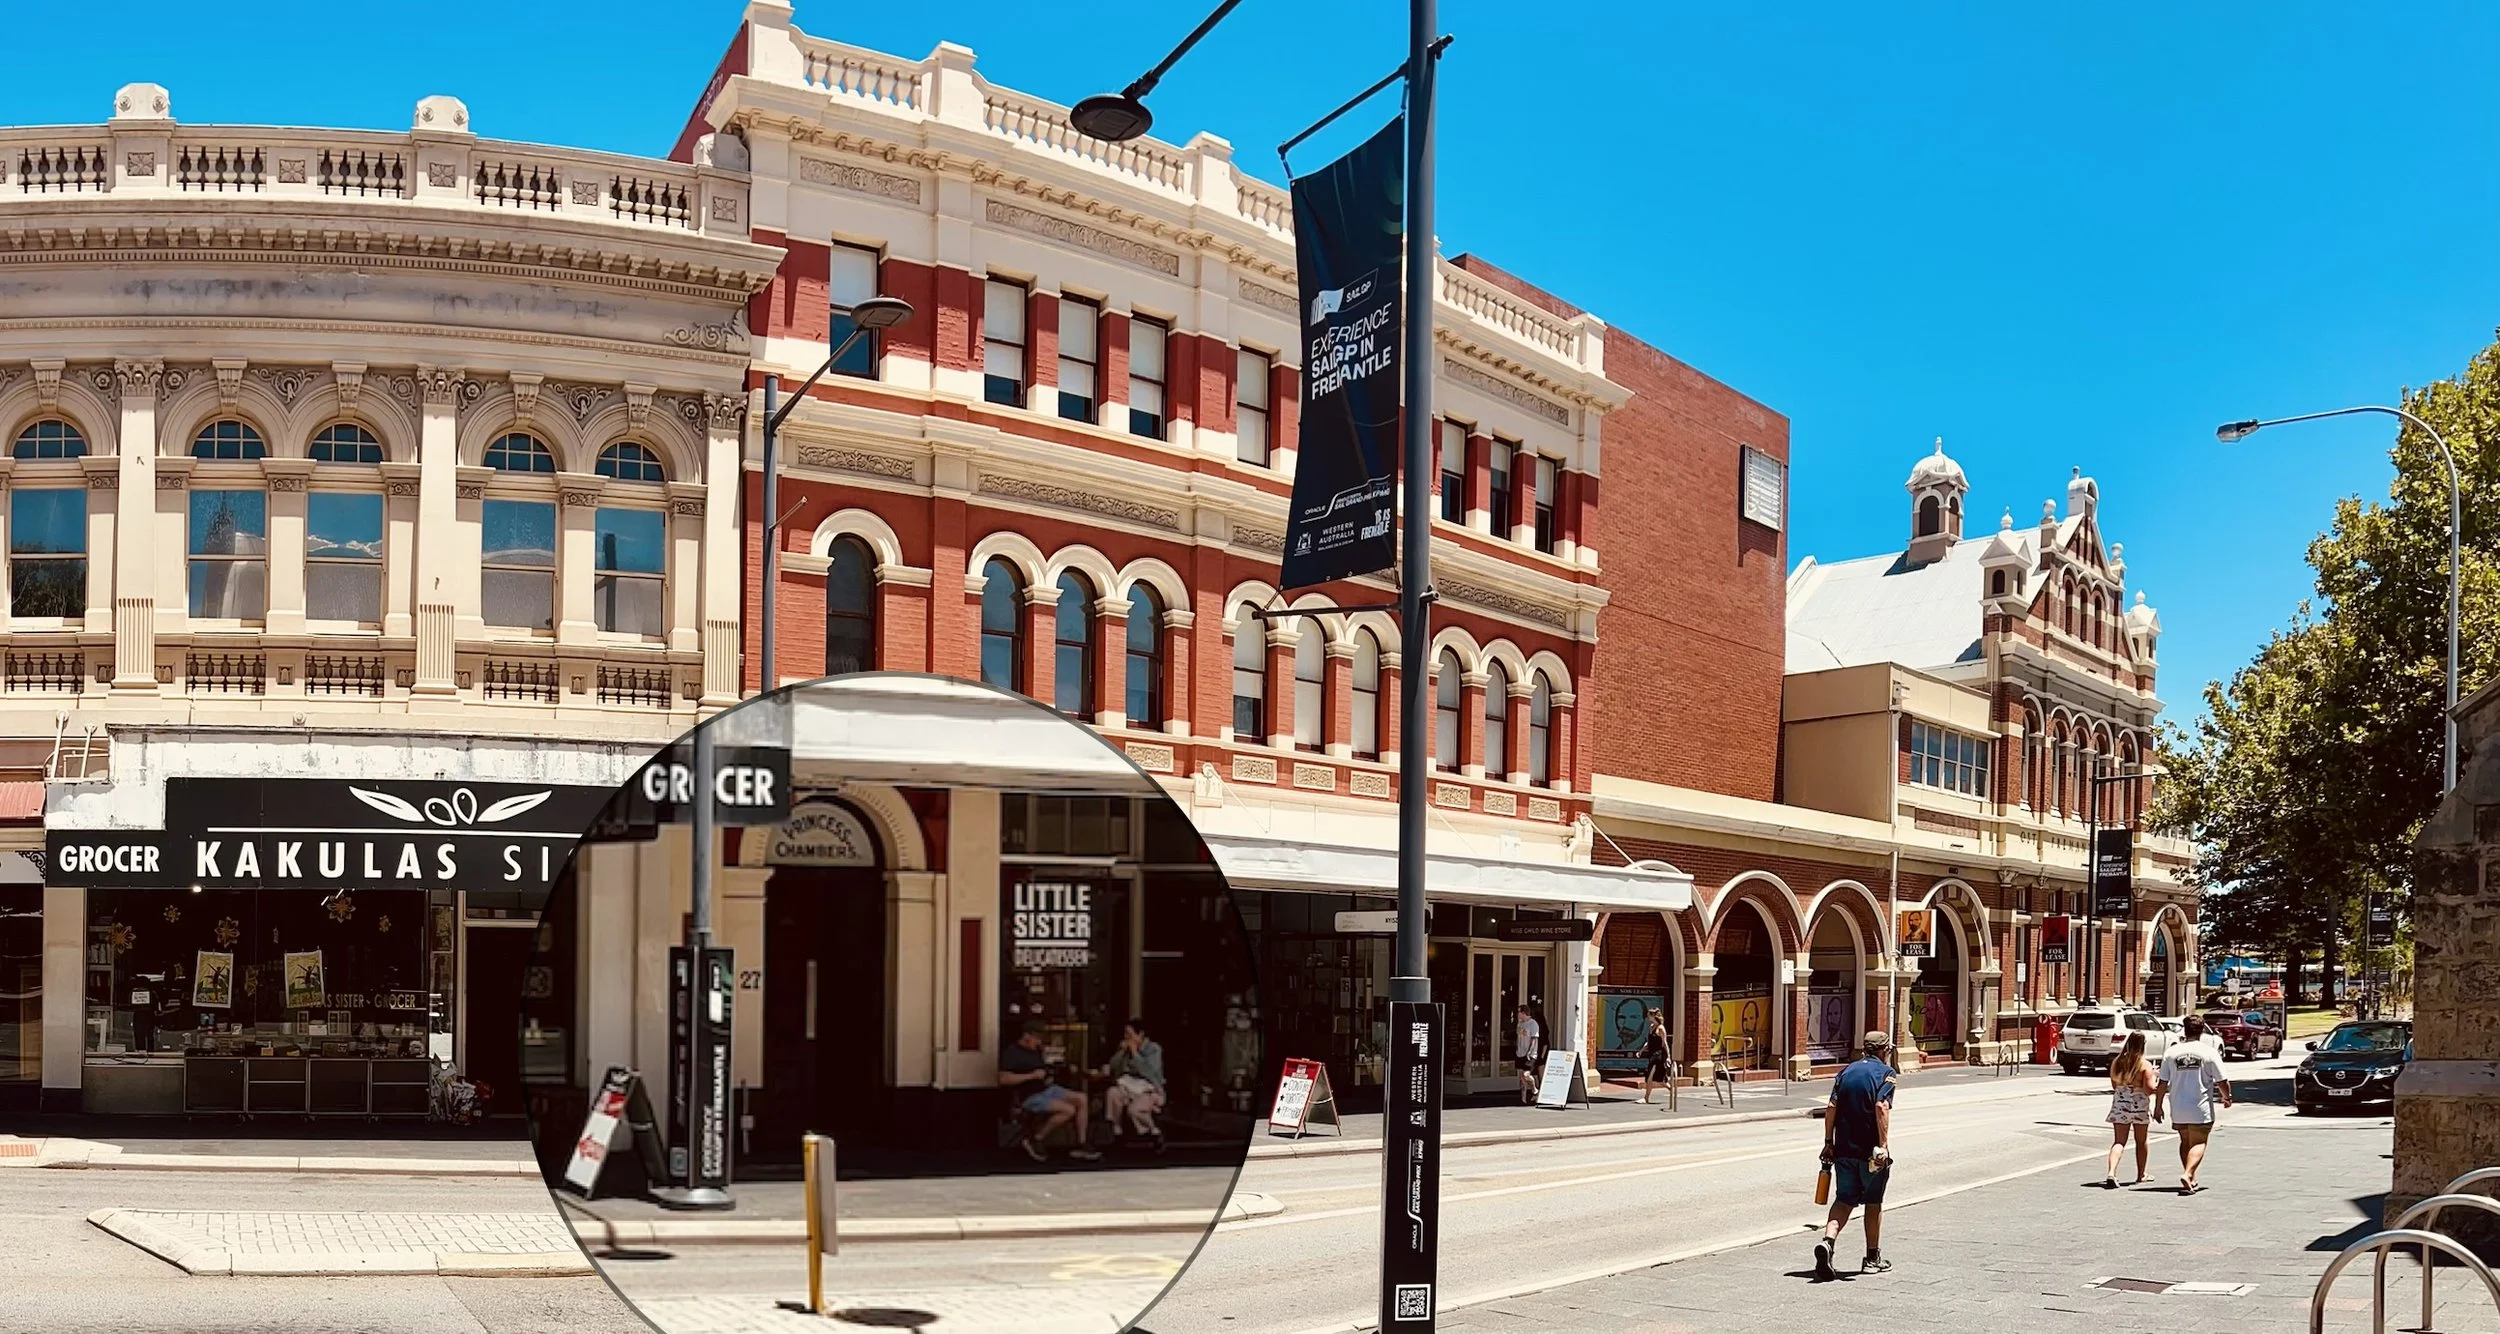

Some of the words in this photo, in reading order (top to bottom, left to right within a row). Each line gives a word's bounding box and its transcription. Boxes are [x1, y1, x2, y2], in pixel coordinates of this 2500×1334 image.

[1360, 334, 1374, 358] IN
[1319, 529, 1356, 545] AUSTRALIA
[1322, 520, 1355, 535] WESTERN
[643, 763, 775, 806] GRCER
[58, 844, 161, 874] GROCER
[196, 840, 457, 881] KAKULAS
[503, 845, 560, 882] SI
[1013, 883, 1092, 911] LITTLE
[1013, 912, 1092, 939] SISTER
[1554, 926, 1572, 934] STORE
[740, 971, 761, 989] 27
[335, 993, 365, 1008] SISTER
[374, 993, 416, 1009] GROCER
[1411, 1030, 1420, 1044] THIS
[1419, 1022, 1429, 1057] FREMANTLE
